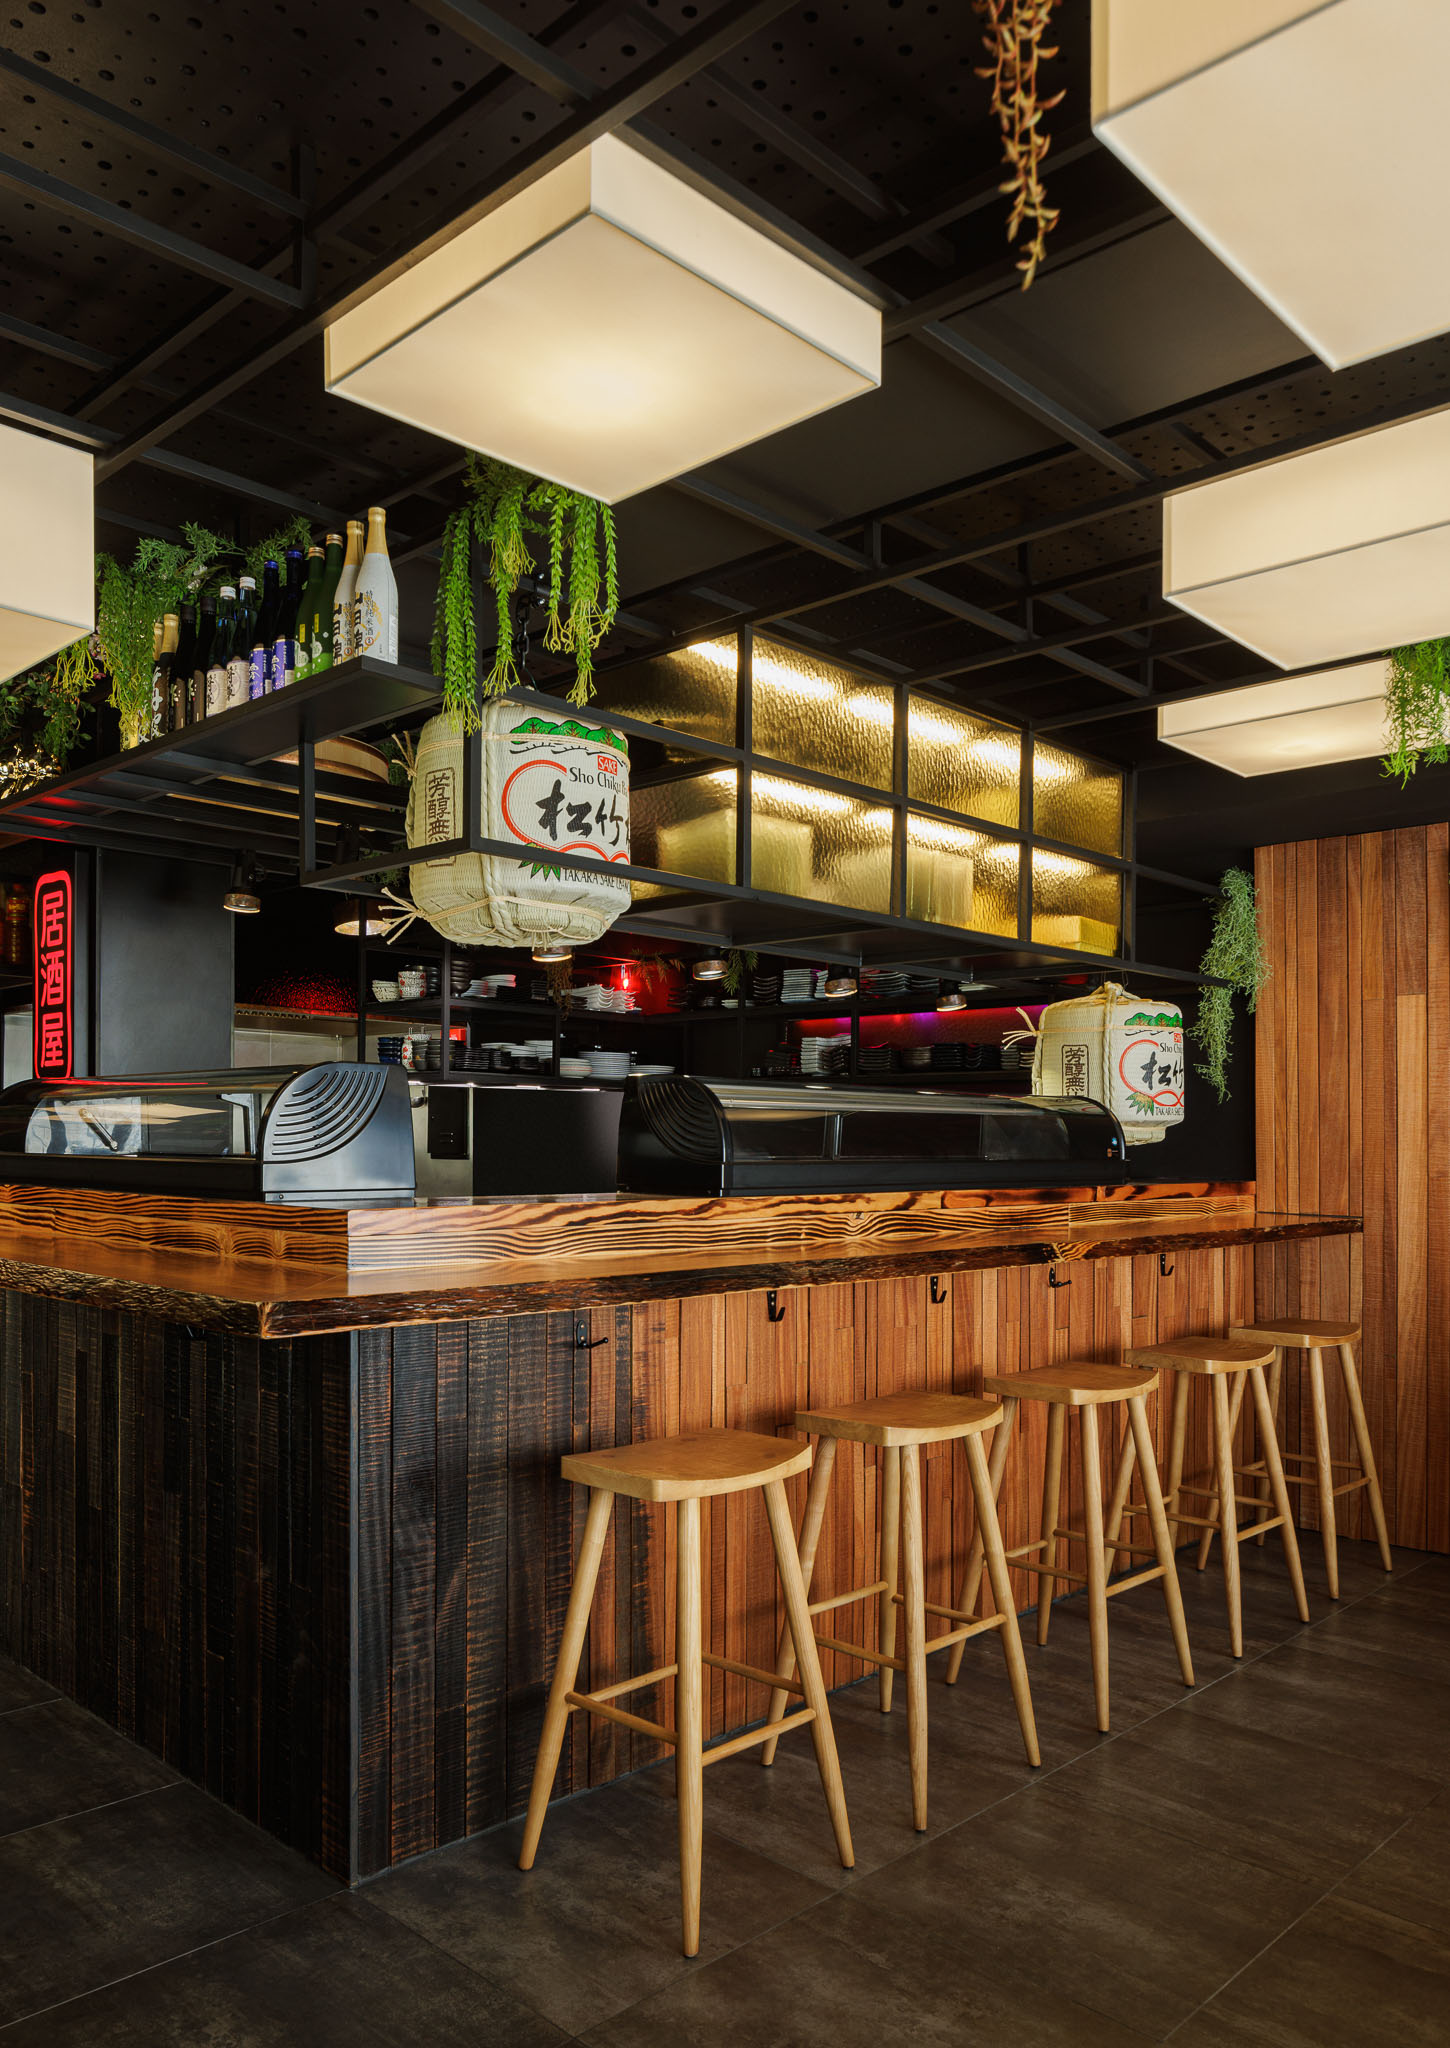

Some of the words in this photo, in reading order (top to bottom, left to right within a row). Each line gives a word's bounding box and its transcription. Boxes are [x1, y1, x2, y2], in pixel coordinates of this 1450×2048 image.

[598, 757, 617, 774] SAKE
[569, 767, 594, 785] Sho
[597, 772, 622, 794] Chiku
[563, 868, 599, 885] TAKARA
[41, 890, 65, 1068] 居酒屋
[1160, 1043, 1172, 1053] Sho
